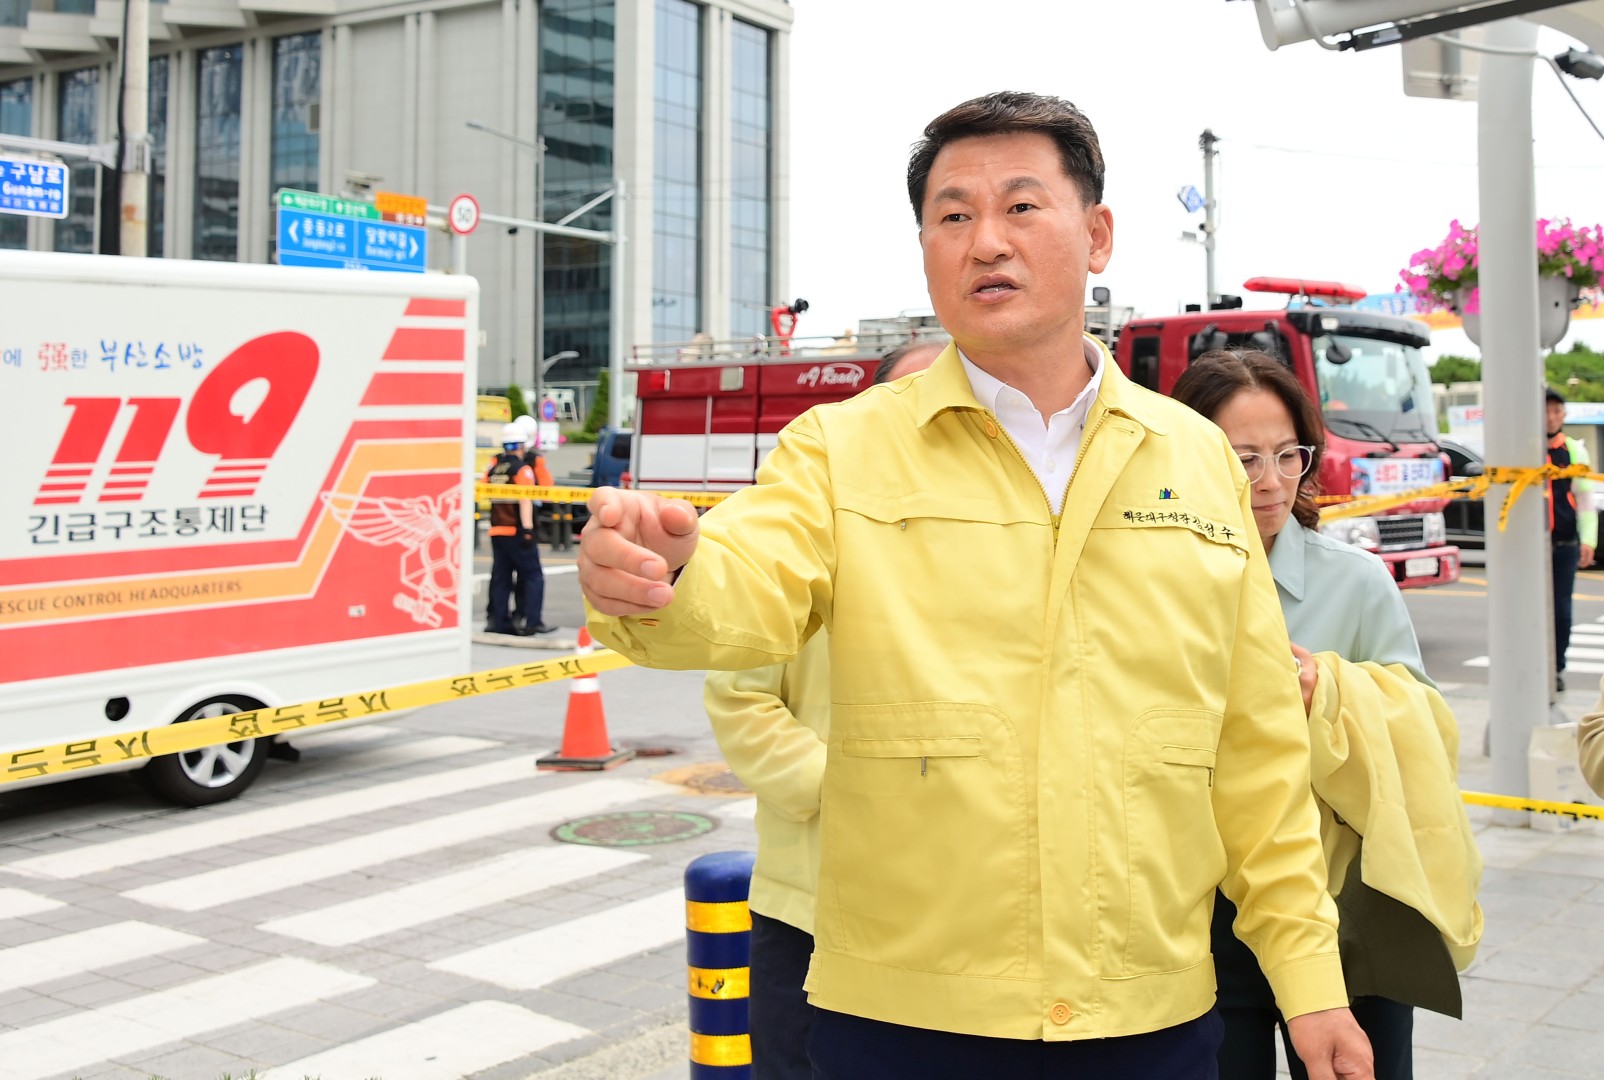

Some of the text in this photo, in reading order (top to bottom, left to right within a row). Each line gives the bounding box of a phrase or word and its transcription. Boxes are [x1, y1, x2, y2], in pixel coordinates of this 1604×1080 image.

[10, 164, 62, 184] 구남로
[101, 339, 203, 372] 부산소방
[821, 363, 864, 388] Ready
[33, 330, 320, 506] 119
[28, 504, 268, 544] 긴급구조통제단
[53, 592, 123, 611] CONTROL
[129, 579, 243, 602] HEADQUARTERS
